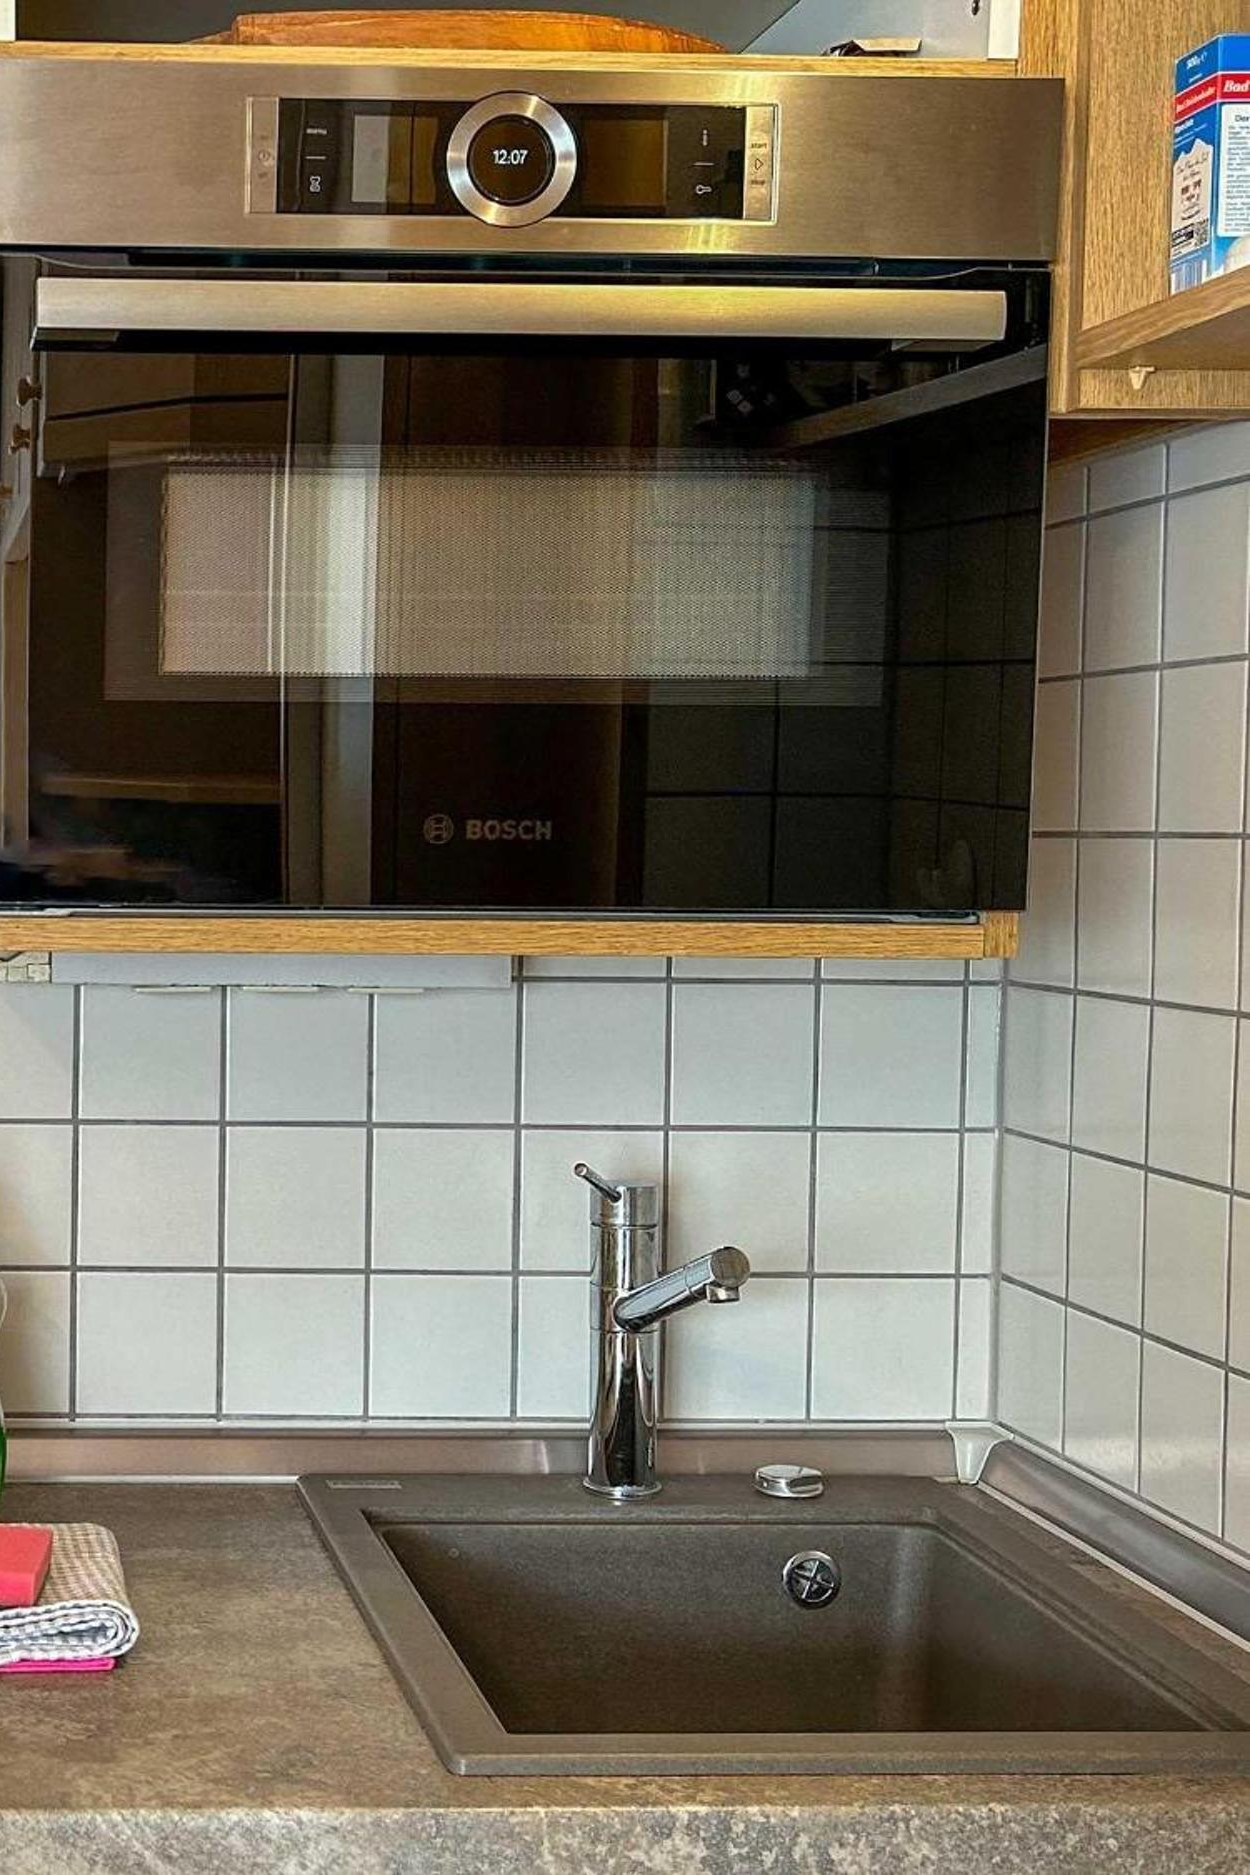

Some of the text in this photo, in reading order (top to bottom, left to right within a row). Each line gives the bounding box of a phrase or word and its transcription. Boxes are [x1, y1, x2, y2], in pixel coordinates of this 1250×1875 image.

[1223, 79, 1250, 93] Bad
[492, 149, 529, 165] 12:07
[465, 819, 552, 841] BOSCH
